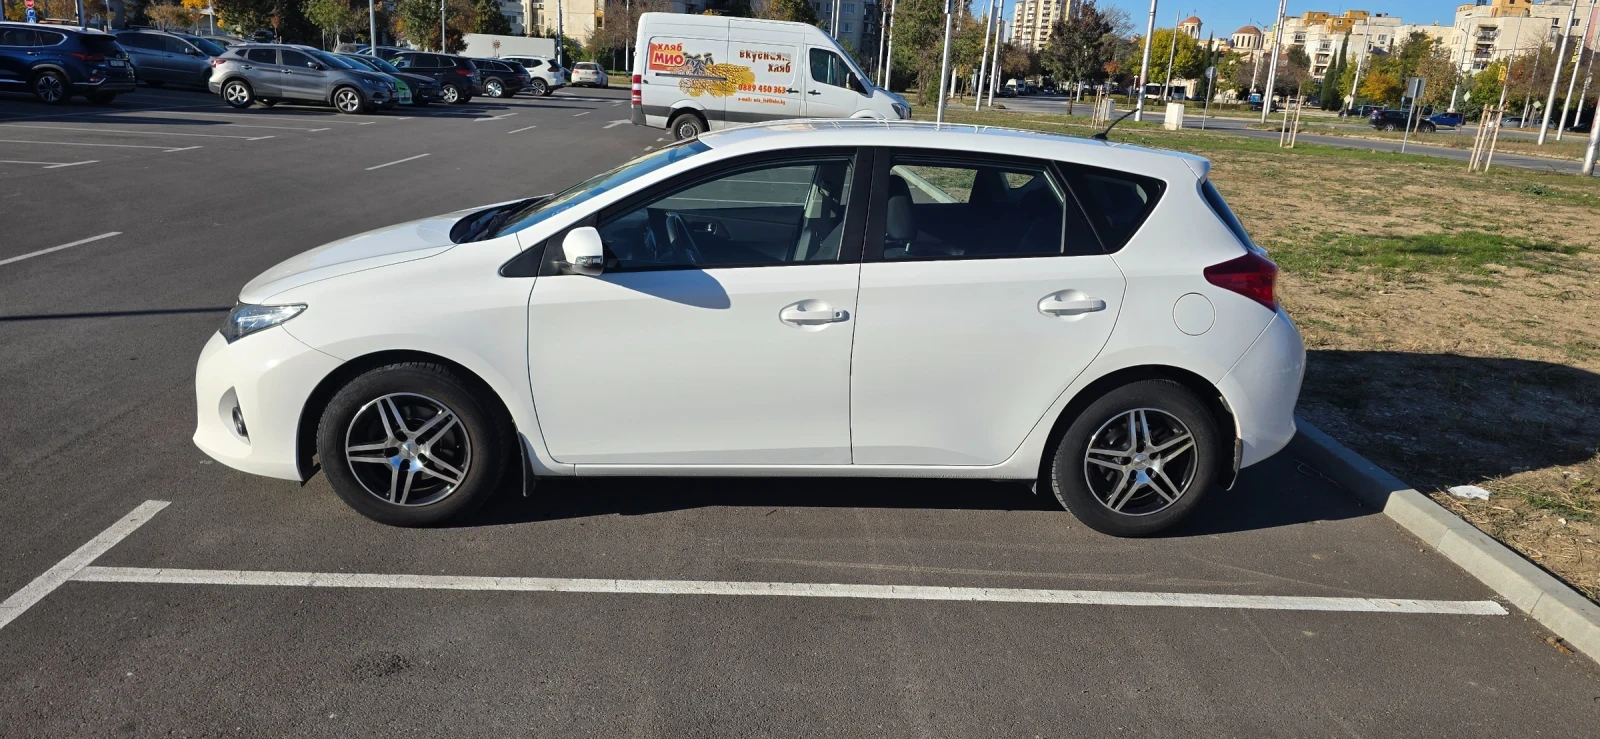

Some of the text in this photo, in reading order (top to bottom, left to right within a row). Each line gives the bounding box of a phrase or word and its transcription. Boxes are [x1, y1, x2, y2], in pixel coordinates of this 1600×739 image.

[653, 52, 684, 65] МИО
[738, 84, 786, 94] 0889 450 363
